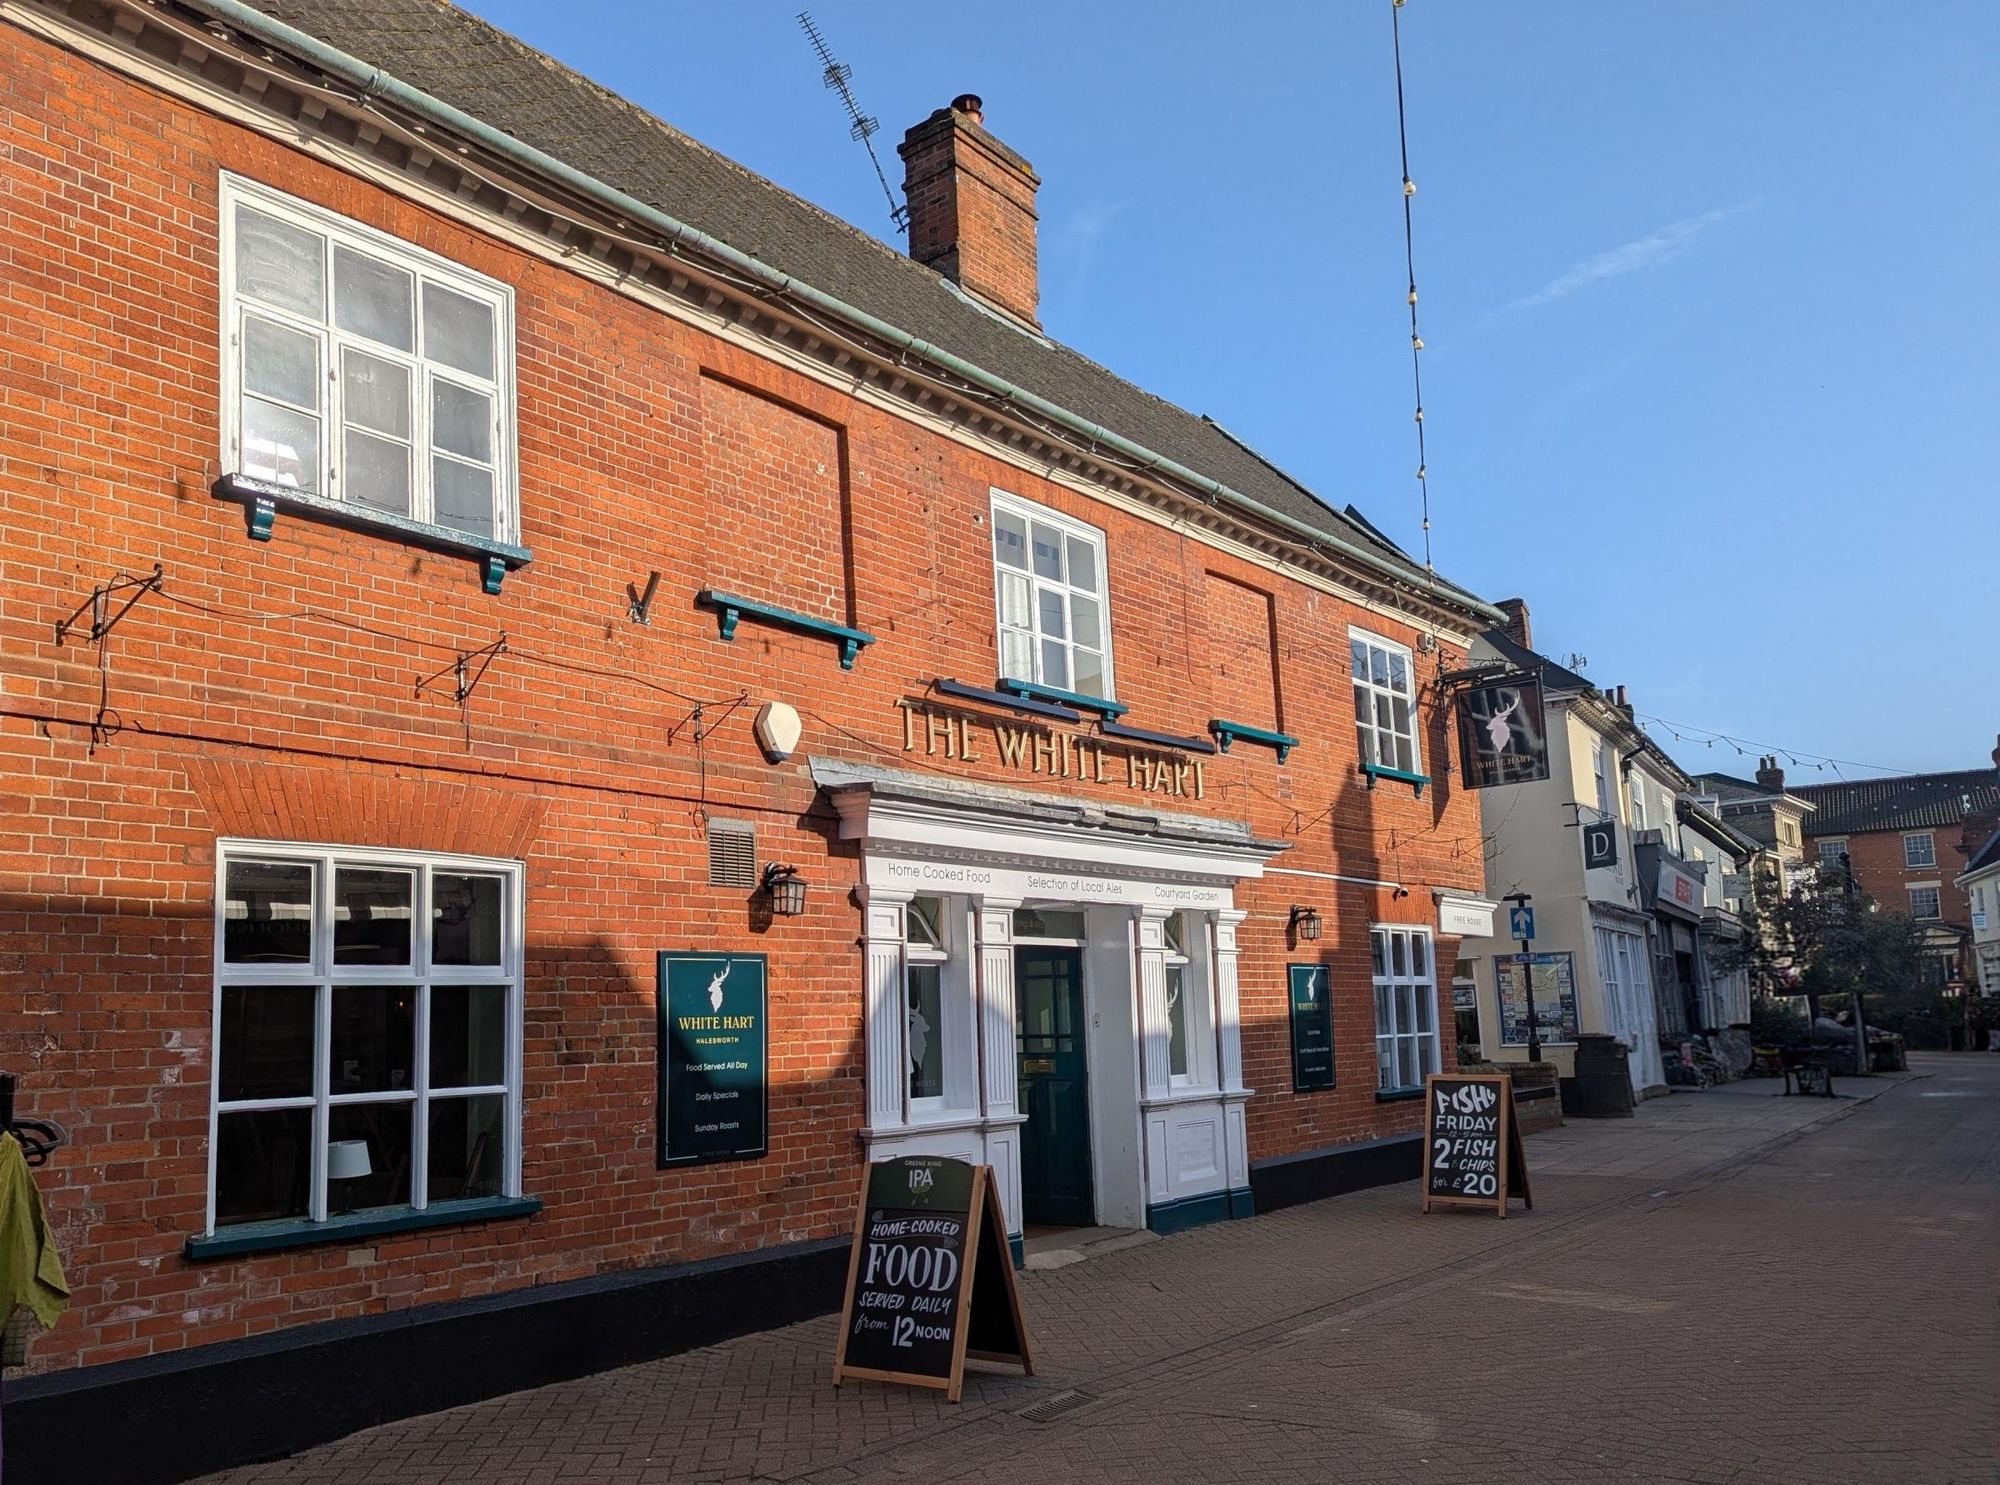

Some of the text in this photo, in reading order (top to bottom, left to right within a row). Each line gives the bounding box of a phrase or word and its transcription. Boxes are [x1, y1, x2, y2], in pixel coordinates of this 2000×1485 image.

[897, 699, 1206, 800] THE WHITE HART
[1476, 755, 1531, 769] WHITE HART
[1590, 832, 1609, 857] D
[888, 862, 991, 883] Home Cooked Food
[1027, 875, 1123, 895] Selection of Local Ales
[1154, 886, 1219, 901] Courtyard Garden
[1453, 915, 1482, 926] FREE HOUSE
[679, 1016, 755, 1030] WHITE HART
[696, 1037, 739, 1045] HALESWORTH
[686, 1061, 748, 1072] Food Served All Day
[695, 1091, 739, 1101] Daily Specials
[694, 1121, 739, 1133] Sunday Roasts
[1436, 1115, 1497, 1131] FRIDAY
[1434, 1138, 1496, 1169] 2 FISH
[1459, 1158, 1495, 1172] CHIPS
[909, 1168, 934, 1189] IPA
[1433, 1176, 1448, 1189] for
[871, 1220, 960, 1236] HOME-COOKED
[864, 1243, 958, 1292] FOOD
[859, 1291, 952, 1314] SERVED DAILY
[855, 1313, 950, 1347] from 12 NOON
